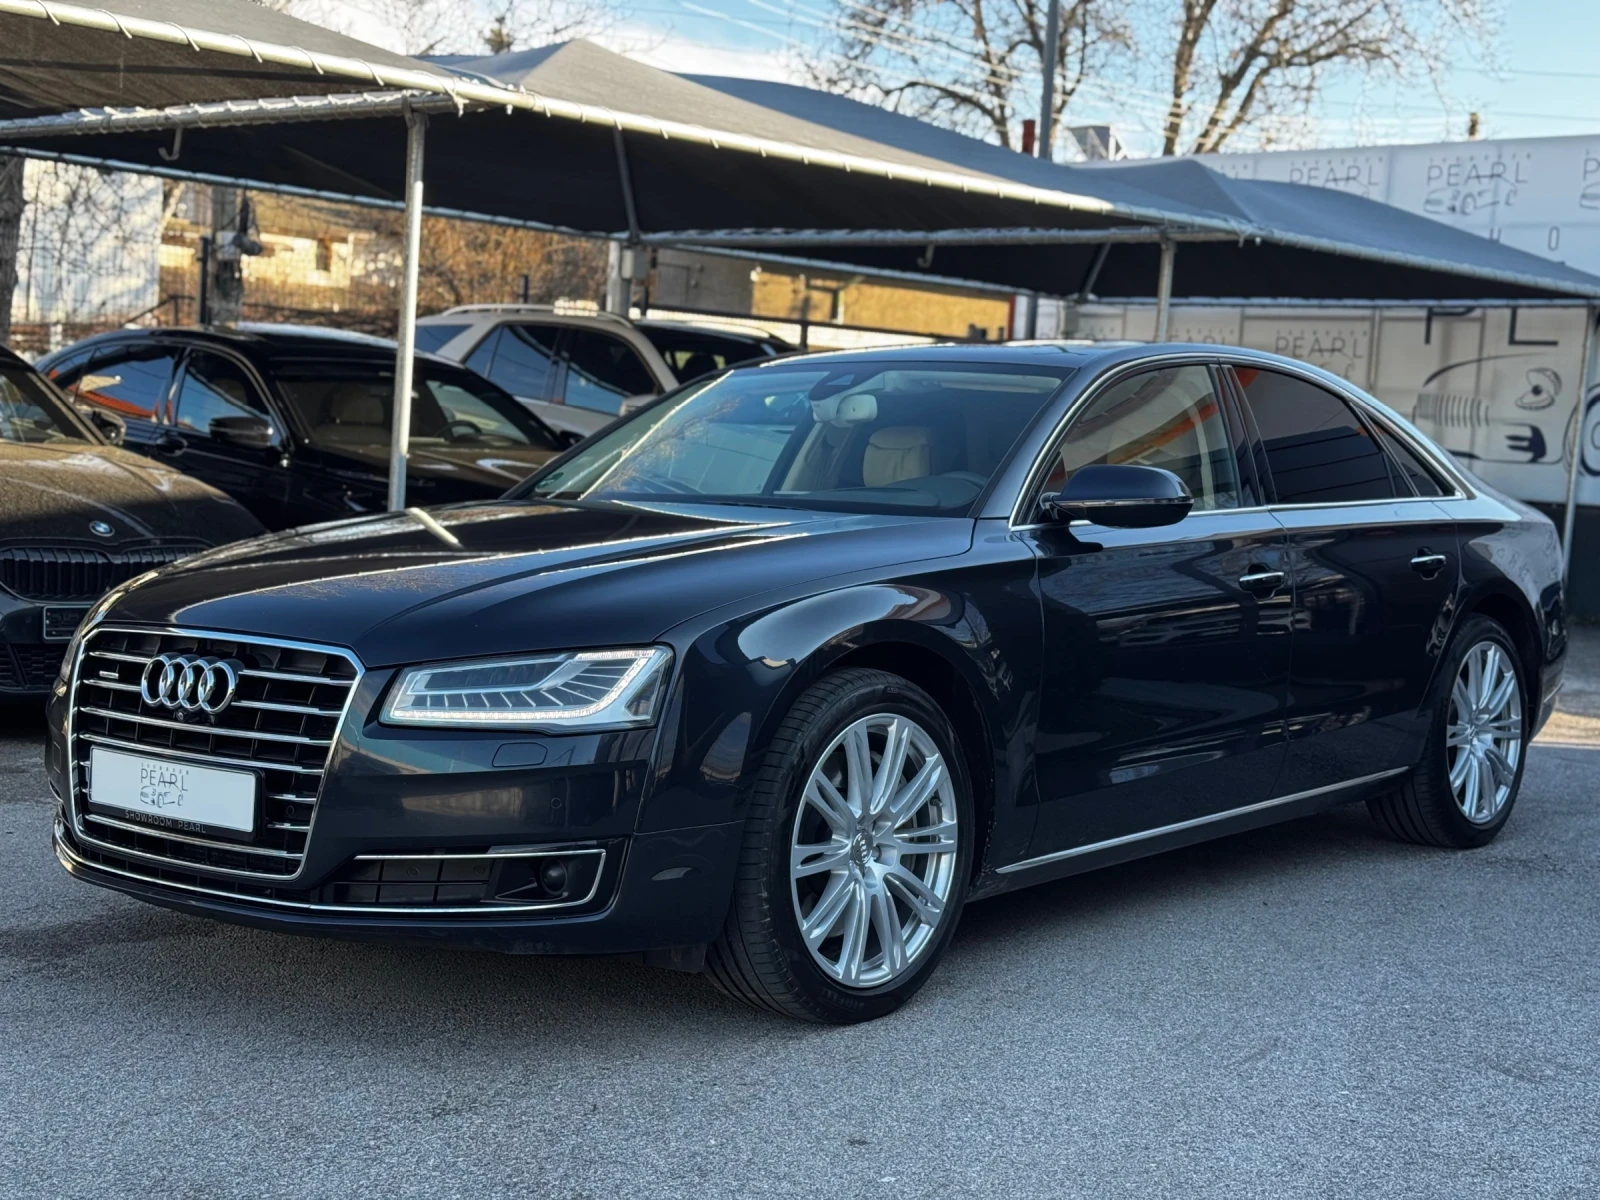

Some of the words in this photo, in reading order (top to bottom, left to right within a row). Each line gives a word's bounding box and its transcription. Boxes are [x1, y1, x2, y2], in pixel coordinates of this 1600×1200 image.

[1290, 165, 1379, 188] PEARL
[1427, 161, 1528, 187] PEARL
[1275, 336, 1363, 359] PEARL
[140, 767, 188, 792] PEARL
[124, 809, 173, 828] SHOWROOM
[177, 820, 207, 834] PEARL
